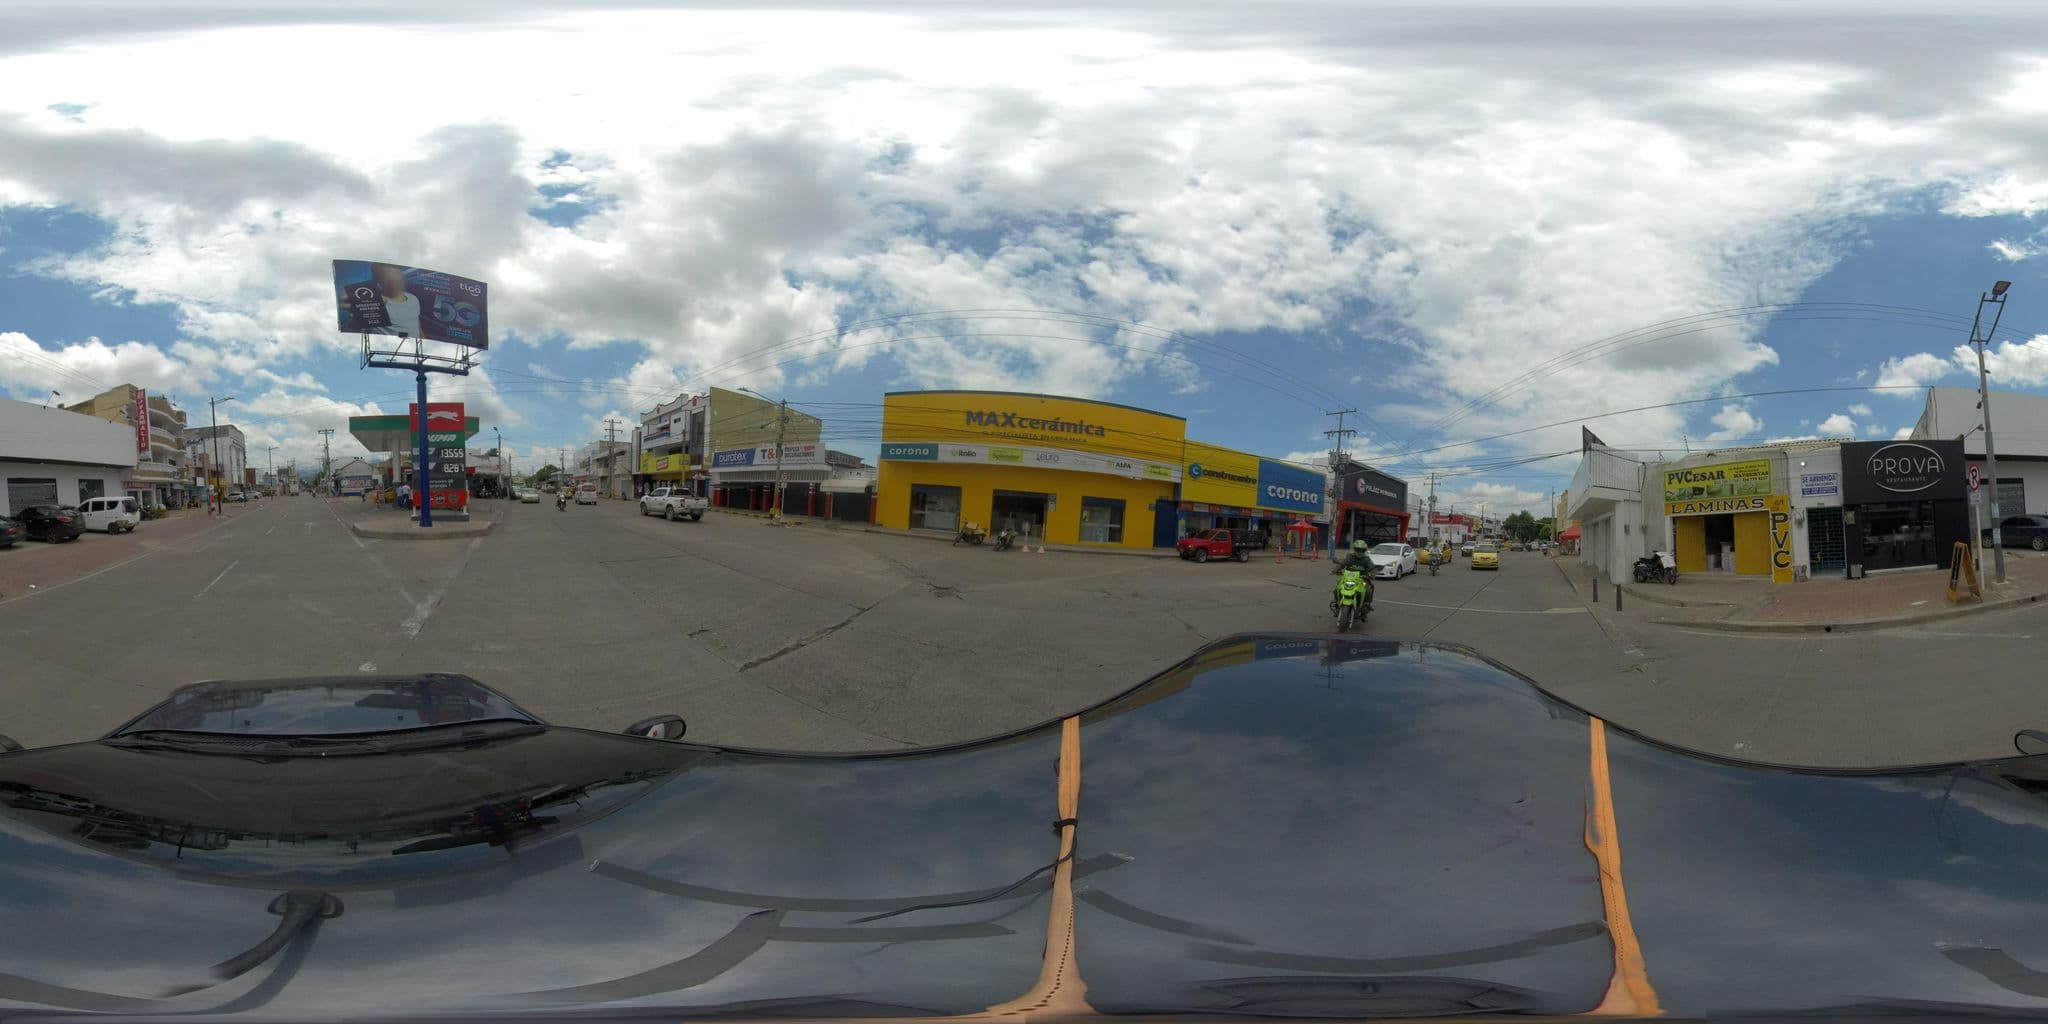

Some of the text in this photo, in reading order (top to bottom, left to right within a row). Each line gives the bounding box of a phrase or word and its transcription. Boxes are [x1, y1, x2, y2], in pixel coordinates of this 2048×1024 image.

[433, 295, 481, 327] 5G
[1873, 457, 1940, 476] PROVA
[1202, 470, 1257, 485] construcentro
[1267, 485, 1319, 504] corona
[1672, 498, 1764, 514] LAMINAS
[1771, 512, 1791, 569] PVC
